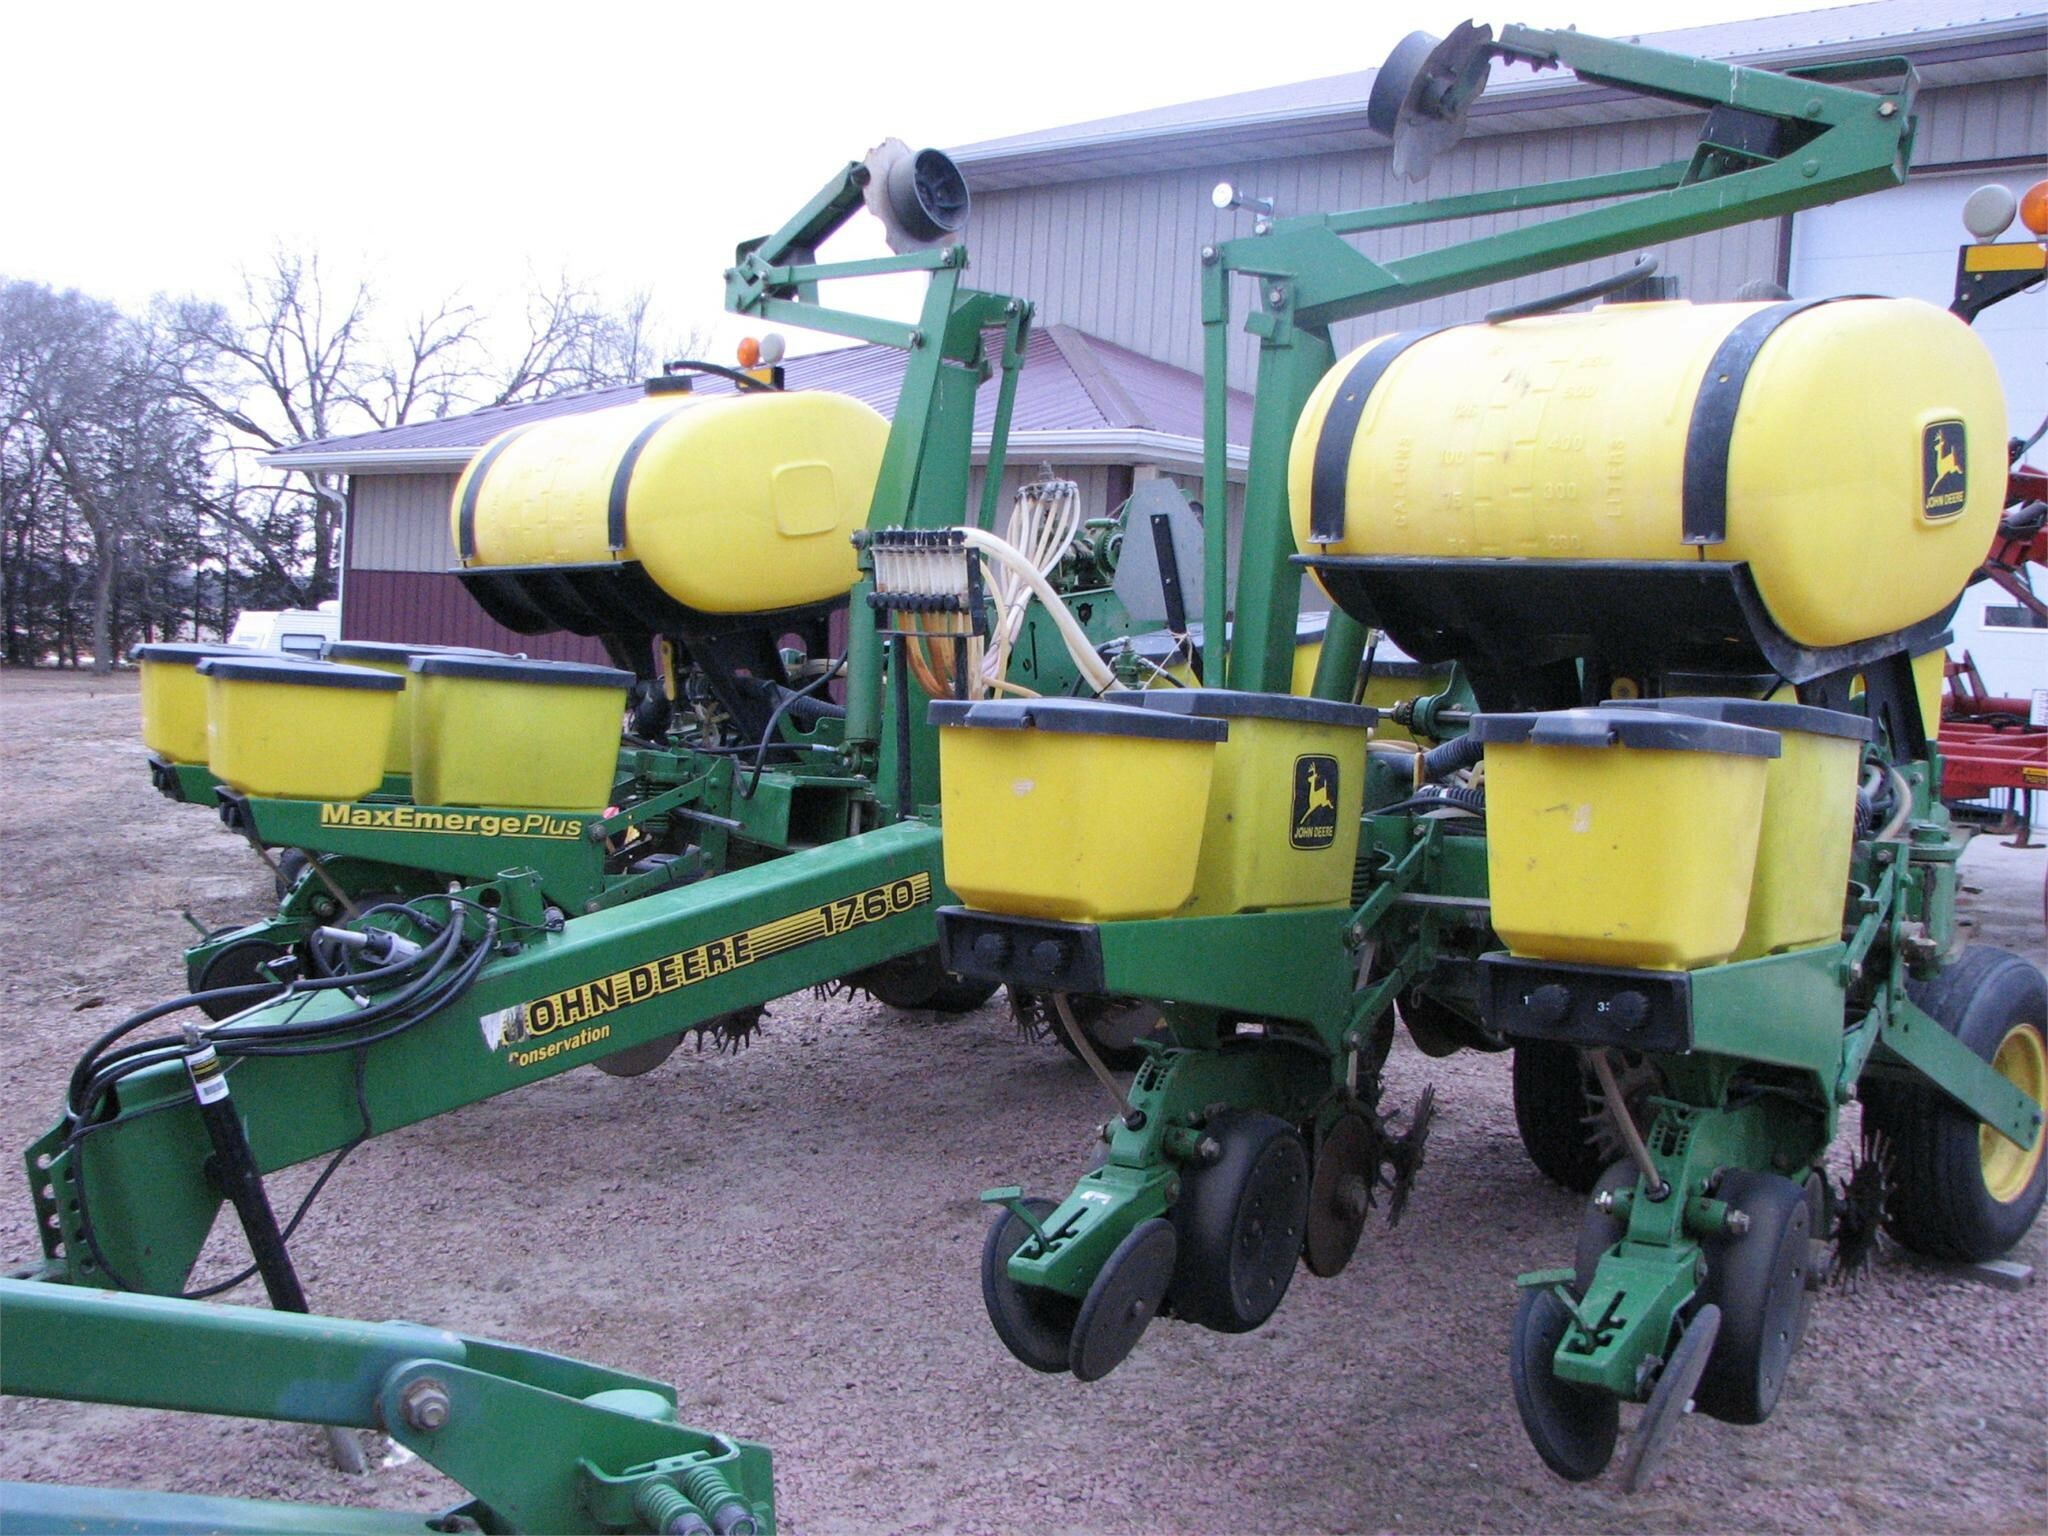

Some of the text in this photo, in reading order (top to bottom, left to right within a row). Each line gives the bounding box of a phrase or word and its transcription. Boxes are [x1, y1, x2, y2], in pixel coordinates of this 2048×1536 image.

[1546, 435, 1583, 452] 400
[1440, 448, 1465, 465] 100
[1606, 438, 1626, 519] LITERS
[1543, 481, 1577, 500] 300
[1926, 491, 1965, 508] JOHN DEERE
[1547, 534, 1582, 551] 200
[1294, 826, 1333, 839] JOHN DEERE
[629, 933, 753, 1001] DEERE
[819, 879, 914, 933] 1760
